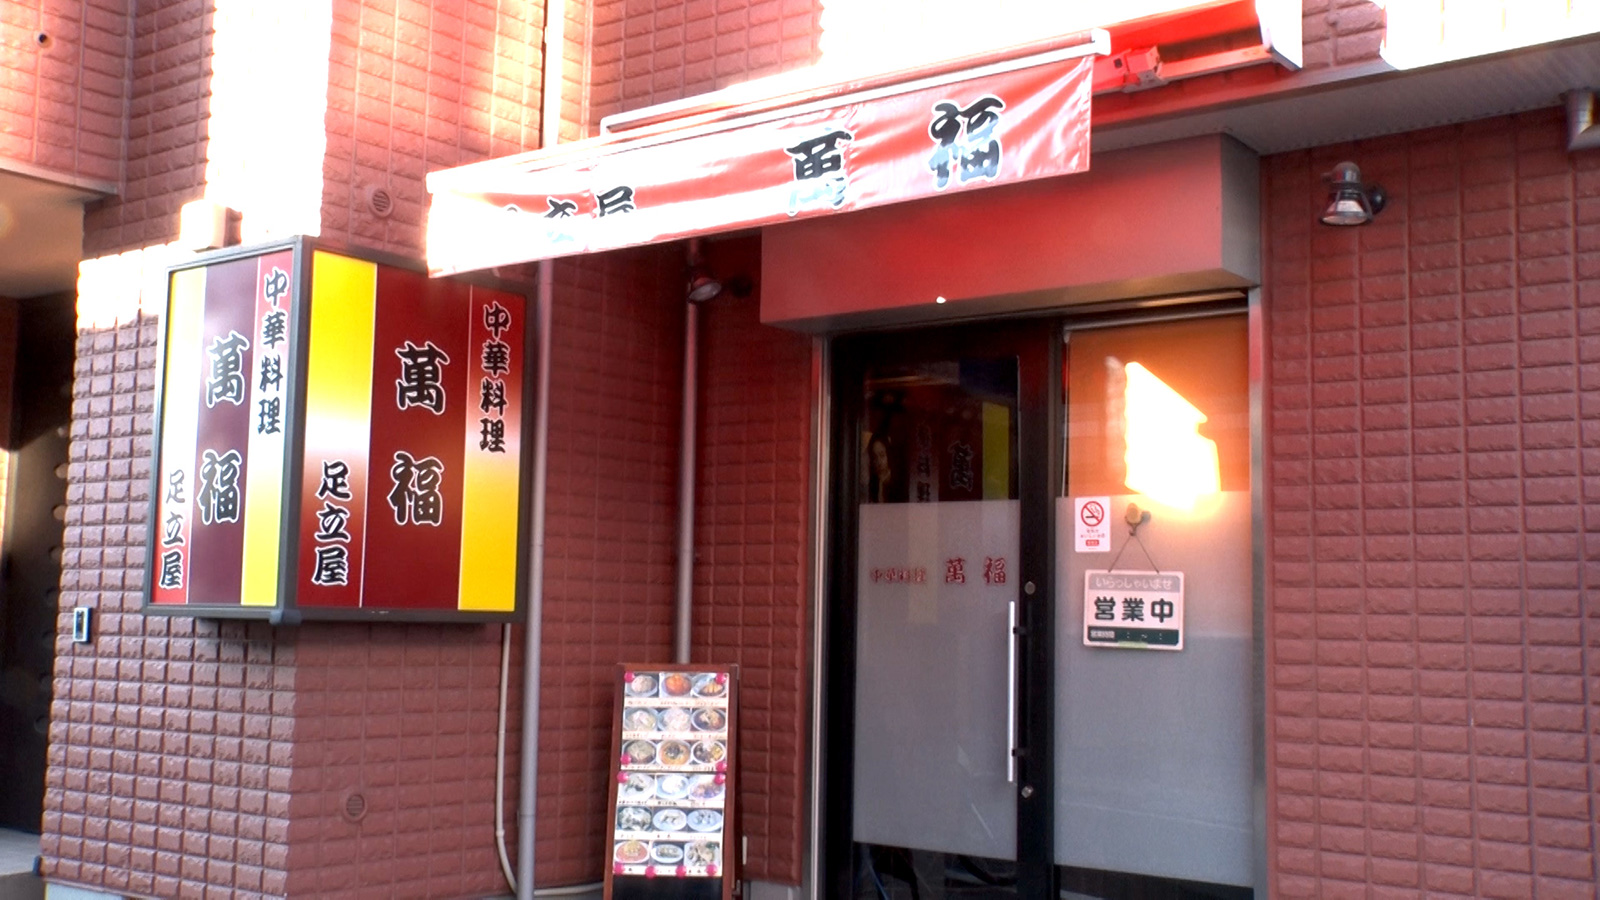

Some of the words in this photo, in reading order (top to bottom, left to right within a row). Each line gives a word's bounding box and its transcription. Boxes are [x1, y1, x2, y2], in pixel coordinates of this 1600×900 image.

[256, 265, 290, 436] 中華料理
[479, 300, 511, 454] 中華料理
[197, 329, 250, 526] 萬福
[387, 339, 450, 527] 萬福
[158, 467, 191, 590] 足立屋
[311, 459, 352, 586] 足立屋
[1095, 577, 1173, 590] いらっしゃいませ
[1094, 595, 1174, 623] 営業中
